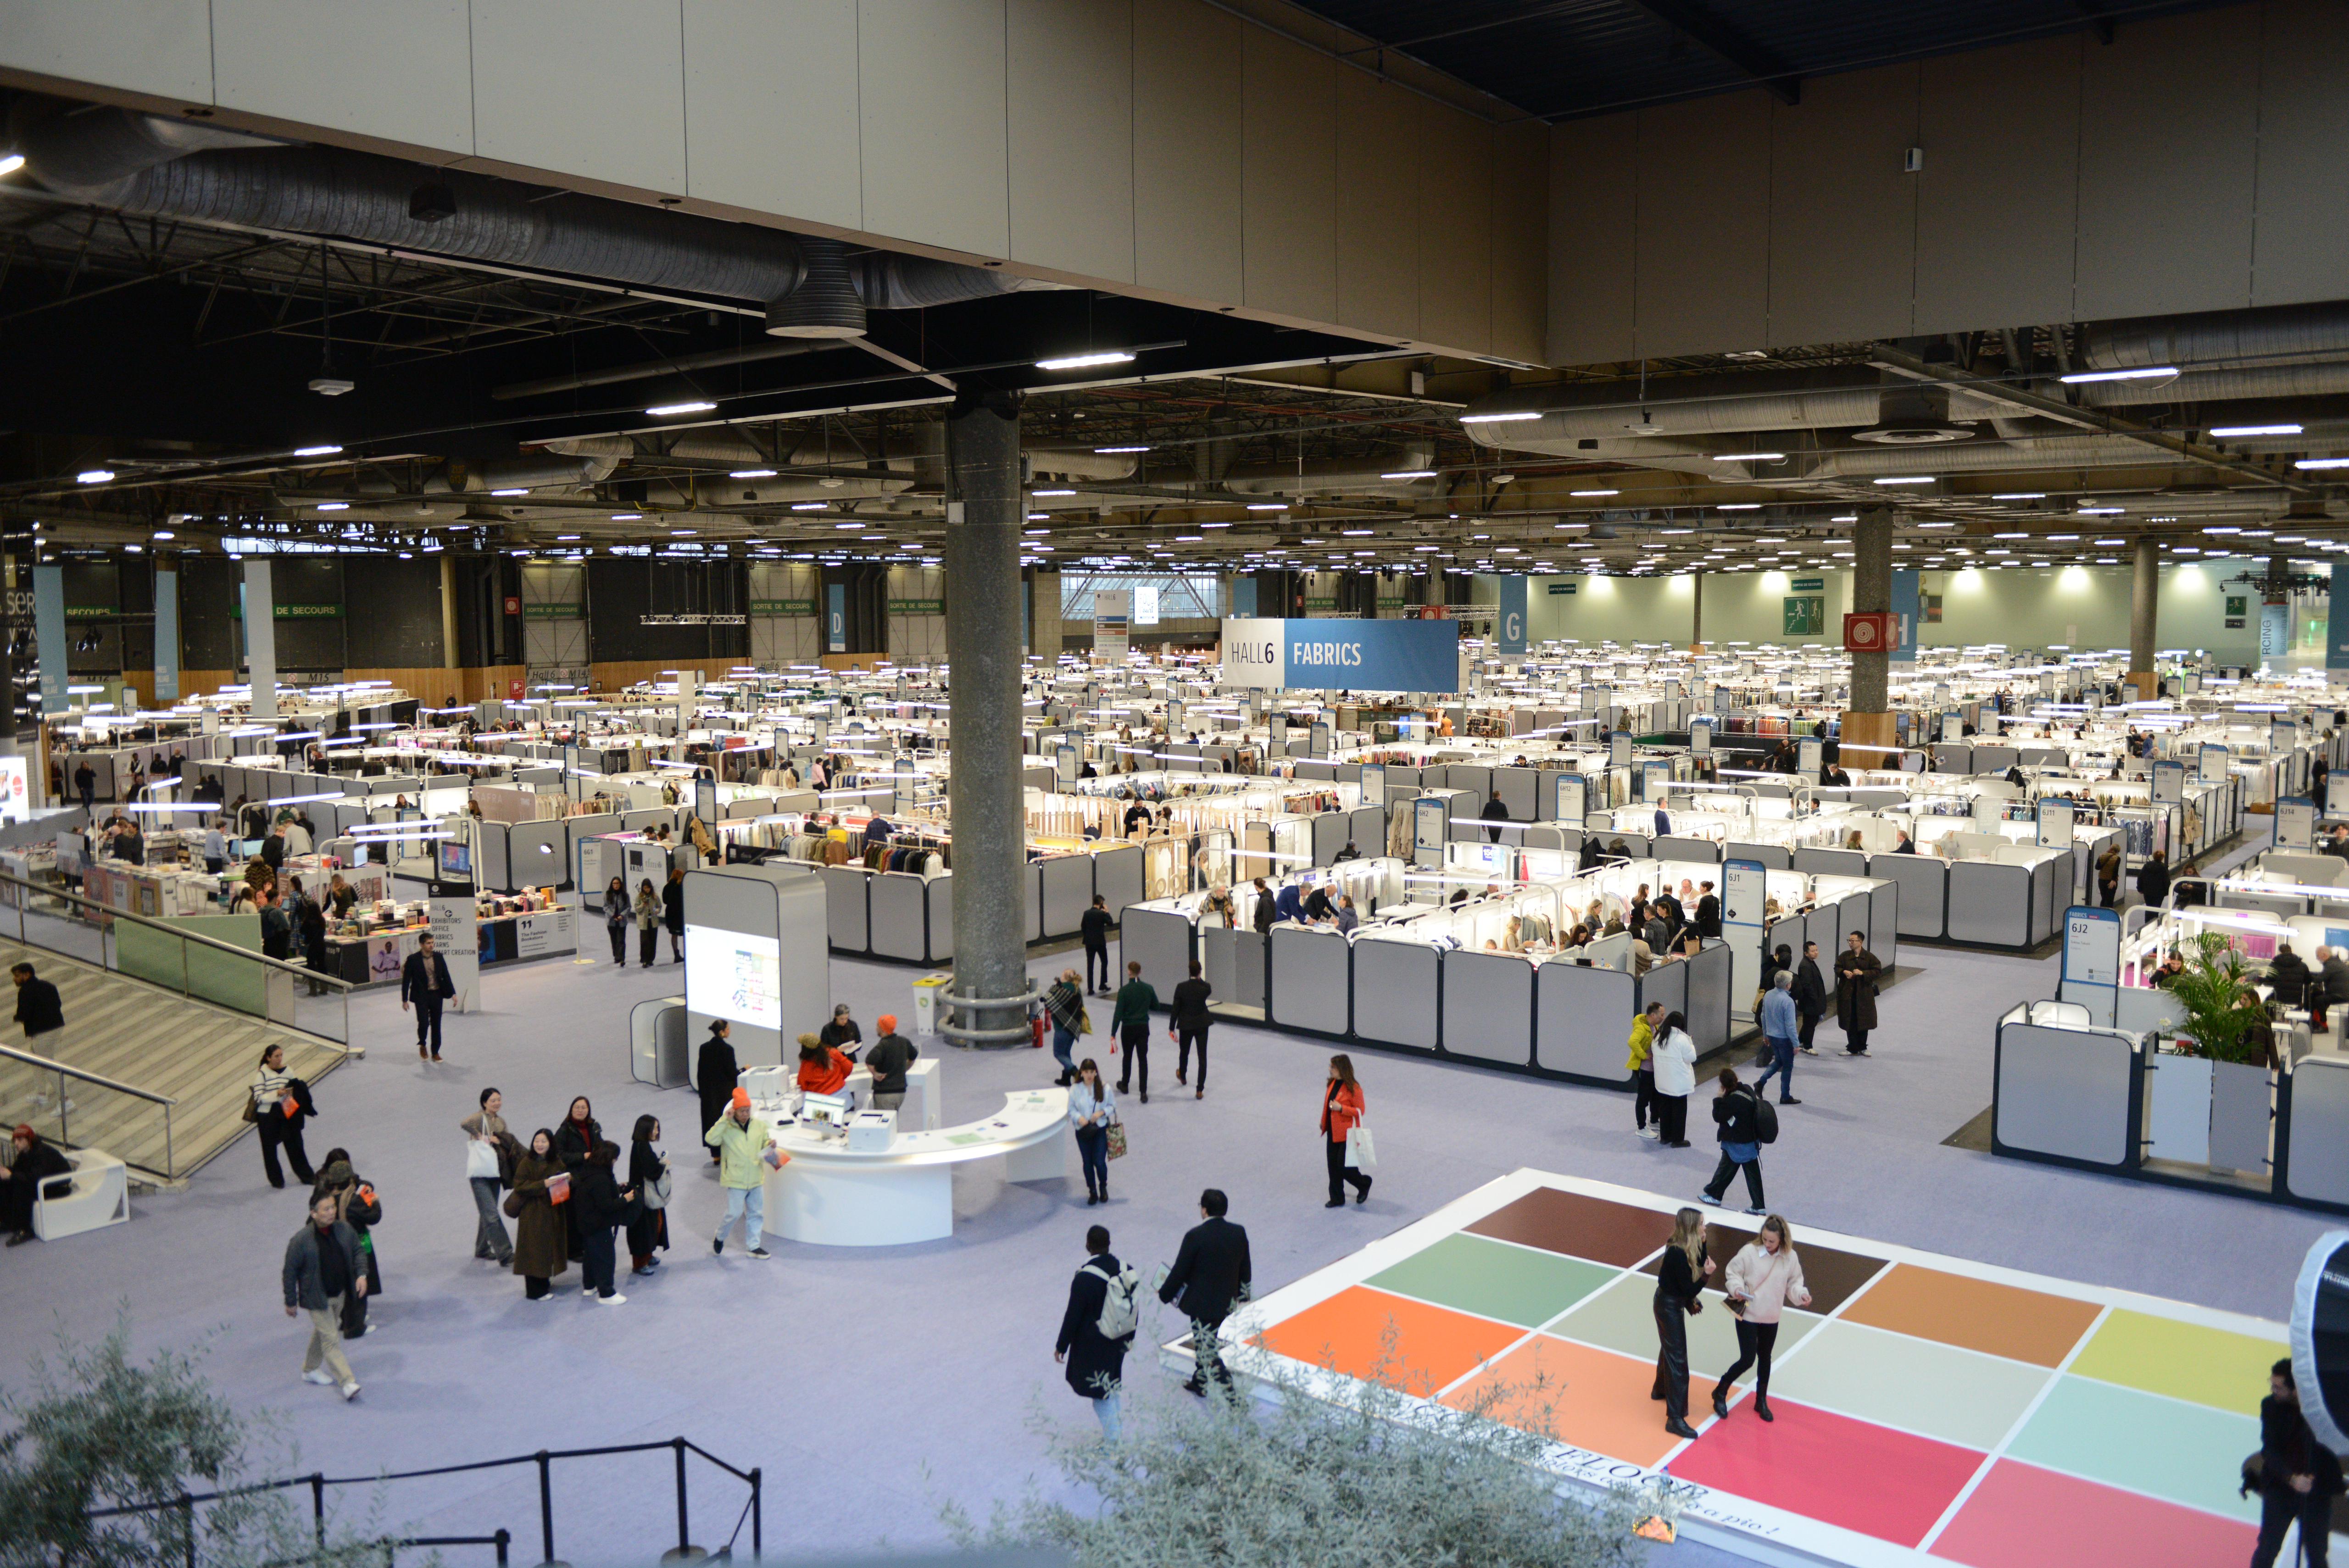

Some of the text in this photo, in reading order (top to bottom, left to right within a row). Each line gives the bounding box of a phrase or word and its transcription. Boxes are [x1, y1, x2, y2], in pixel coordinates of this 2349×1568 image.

[833, 612, 841, 634] D
[1506, 612, 1520, 641] G
[1231, 642, 1361, 666] HALL6 FABRICS
[308, 673, 329, 683] M15
[475, 792, 502, 802] SAFRA
[1729, 873, 1740, 882] 6J1
[2072, 923, 2088, 934] 6J2
